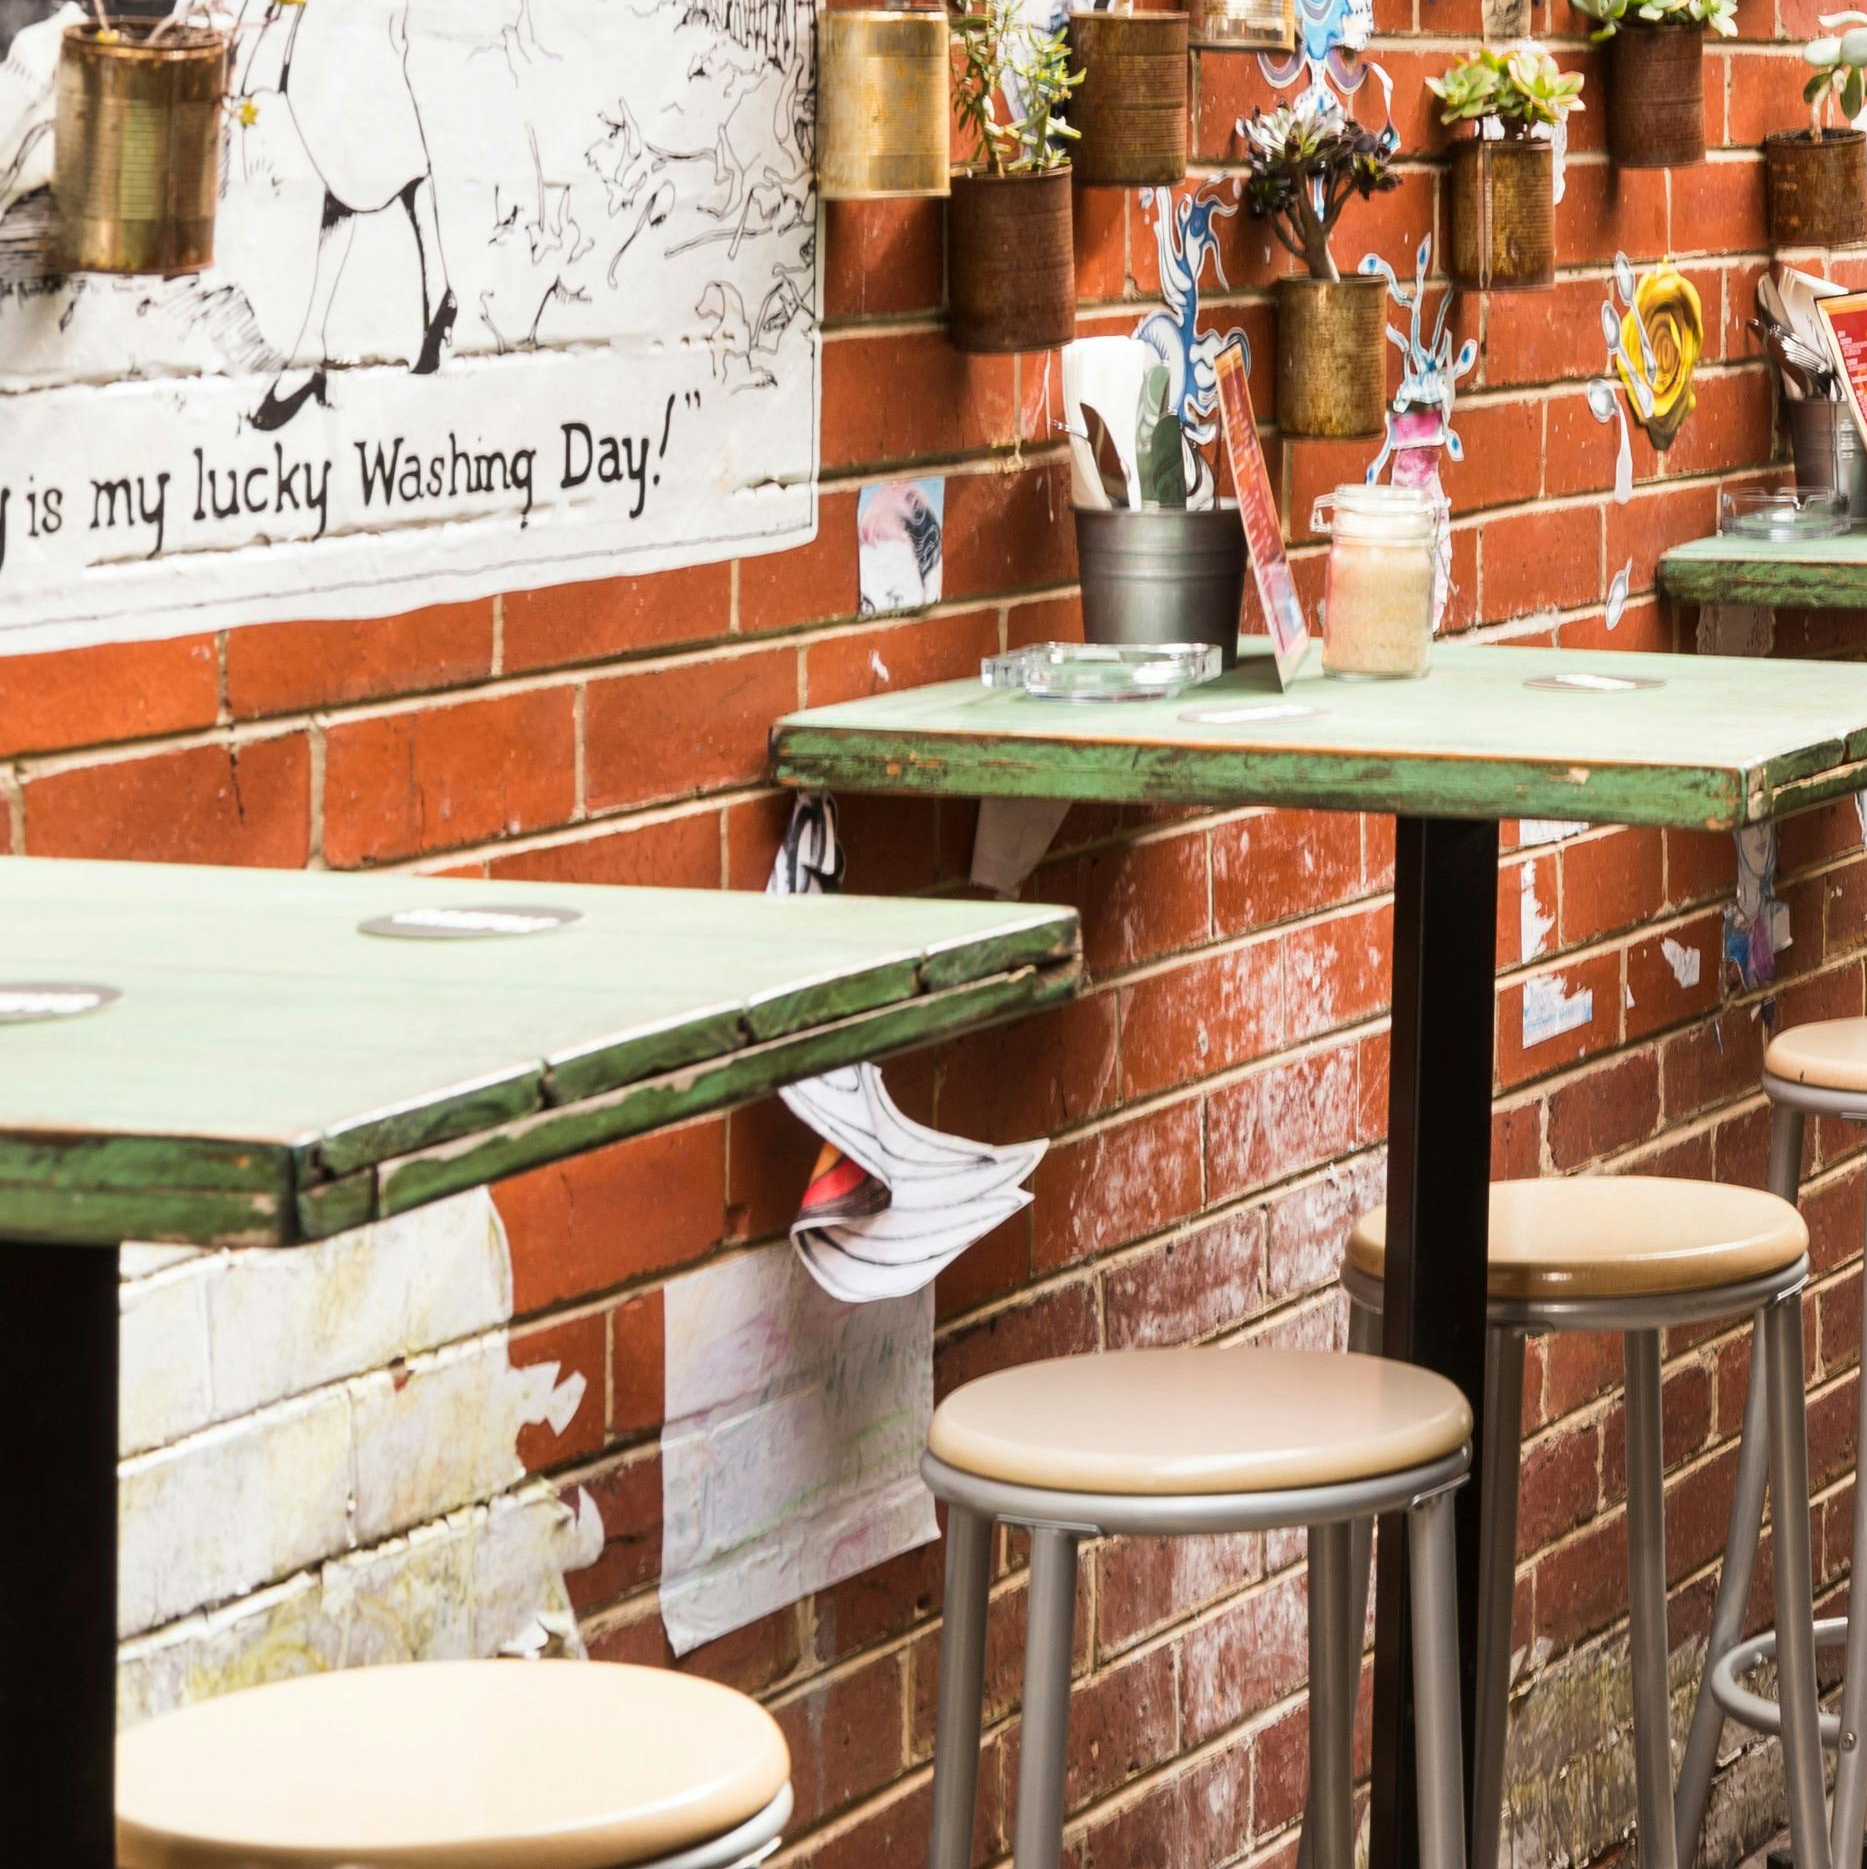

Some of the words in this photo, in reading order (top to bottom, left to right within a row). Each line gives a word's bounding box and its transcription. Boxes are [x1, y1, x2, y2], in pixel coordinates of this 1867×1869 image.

[26, 470, 64, 537] is
[88, 472, 170, 561] my
[192, 443, 331, 542] lucky
[354, 432, 536, 529] Washing
